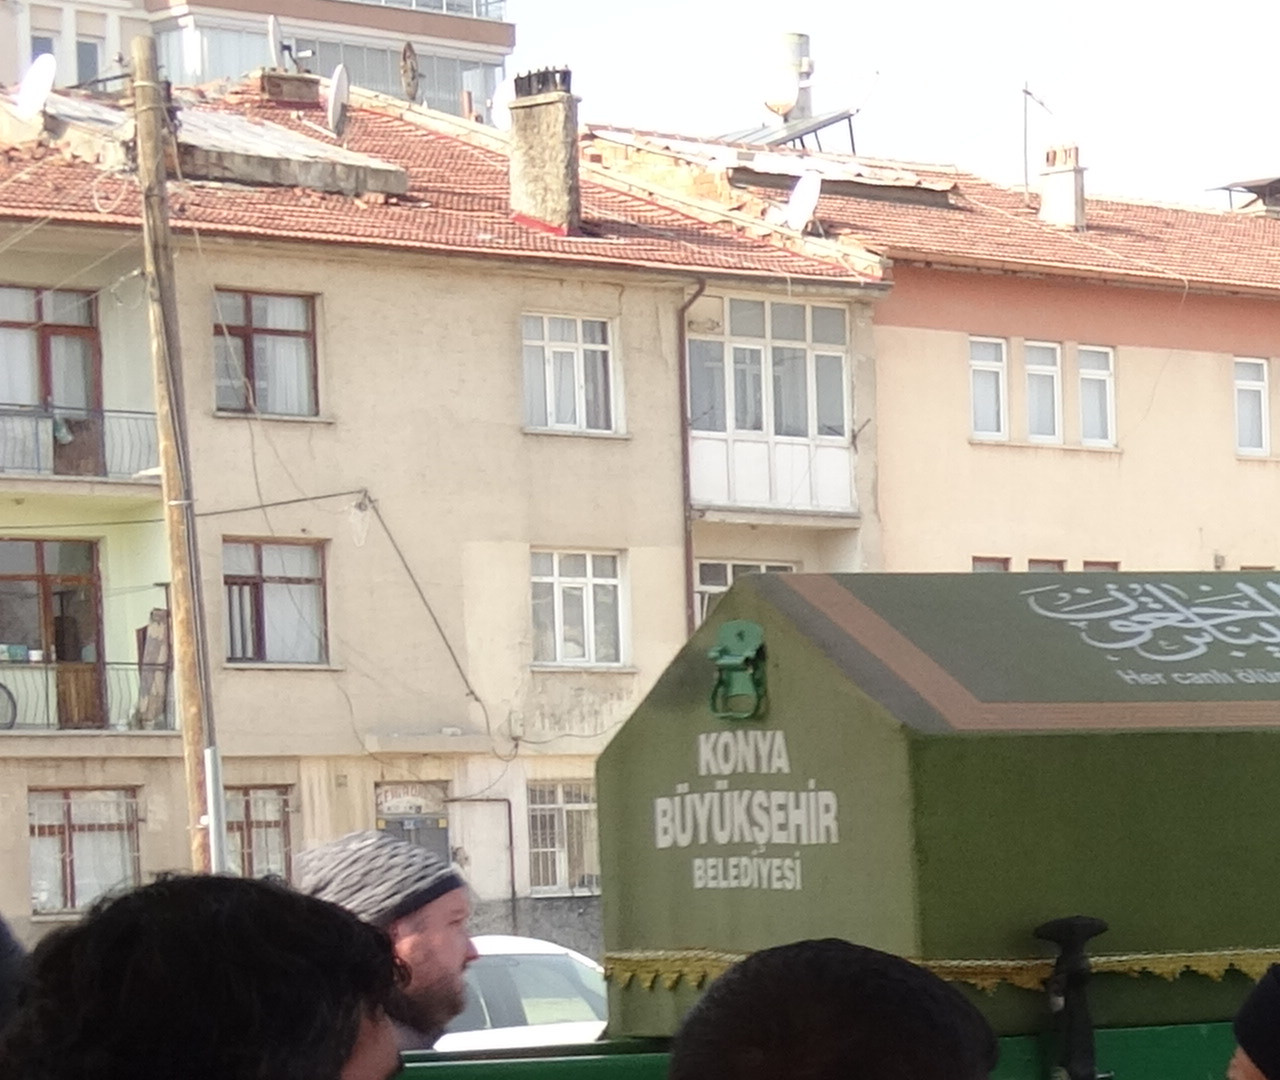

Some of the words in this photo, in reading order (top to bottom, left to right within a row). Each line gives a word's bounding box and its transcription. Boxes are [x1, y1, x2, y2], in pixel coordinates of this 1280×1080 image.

[1116, 668, 1168, 685] Her
[1170, 668, 1235, 685] canlı
[698, 730, 791, 776] KONYA
[655, 778, 840, 854] BÜYÜKŞEHİR
[692, 850, 802, 890] BELEDİYESİ
